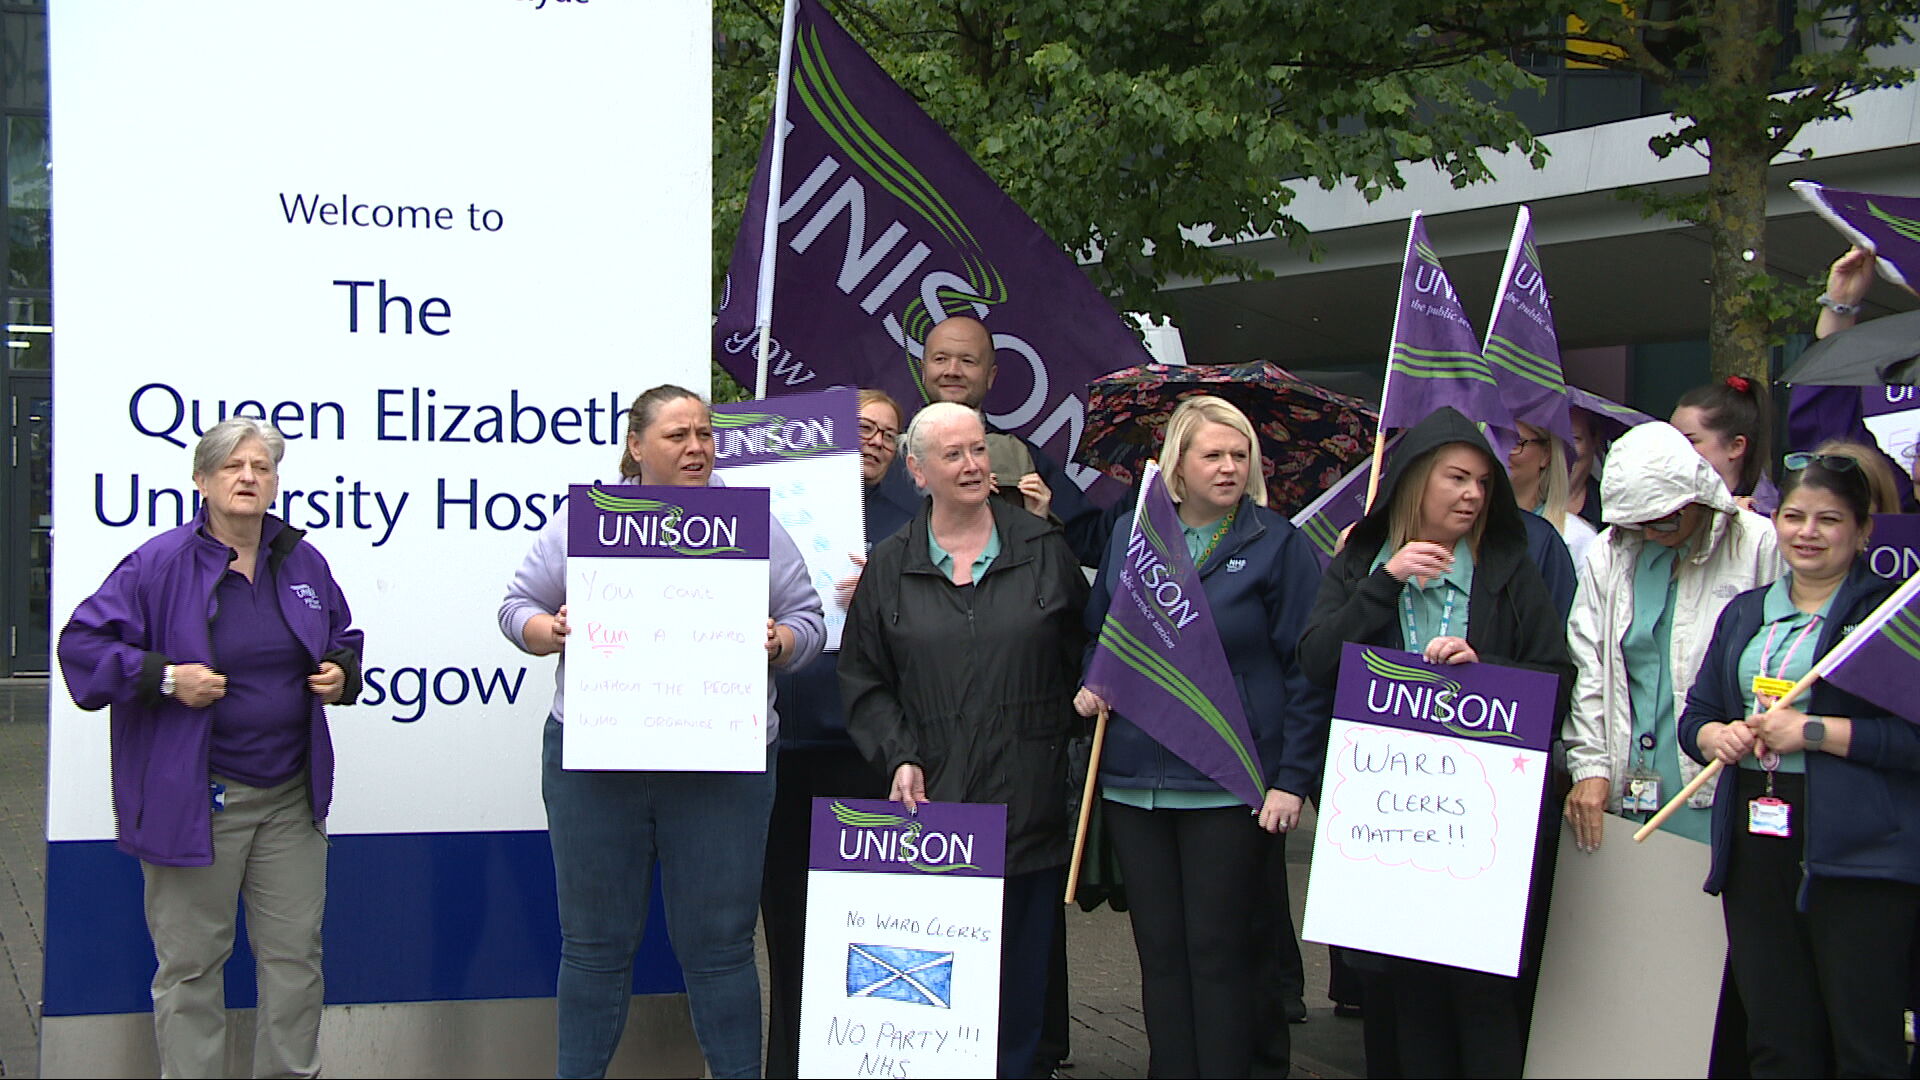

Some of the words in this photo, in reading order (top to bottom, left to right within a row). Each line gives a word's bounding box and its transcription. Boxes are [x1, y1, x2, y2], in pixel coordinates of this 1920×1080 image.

[279, 193, 453, 230] Welcome
[467, 202, 503, 232] to
[333, 279, 452, 336] The
[377, 387, 631, 445] Elizabeth
[713, 416, 834, 458] UNISON
[598, 514, 739, 547] UNISON
[655, 629, 666, 643] A
[362, 667, 527, 723] sgow
[653, 682, 684, 696] THE
[1367, 679, 1518, 733] UNISON
[1354, 742, 1456, 776] WARD
[1377, 790, 1466, 816] CLERKS
[838, 828, 974, 865] UNISON
[857, 1052, 911, 1079] NHS
